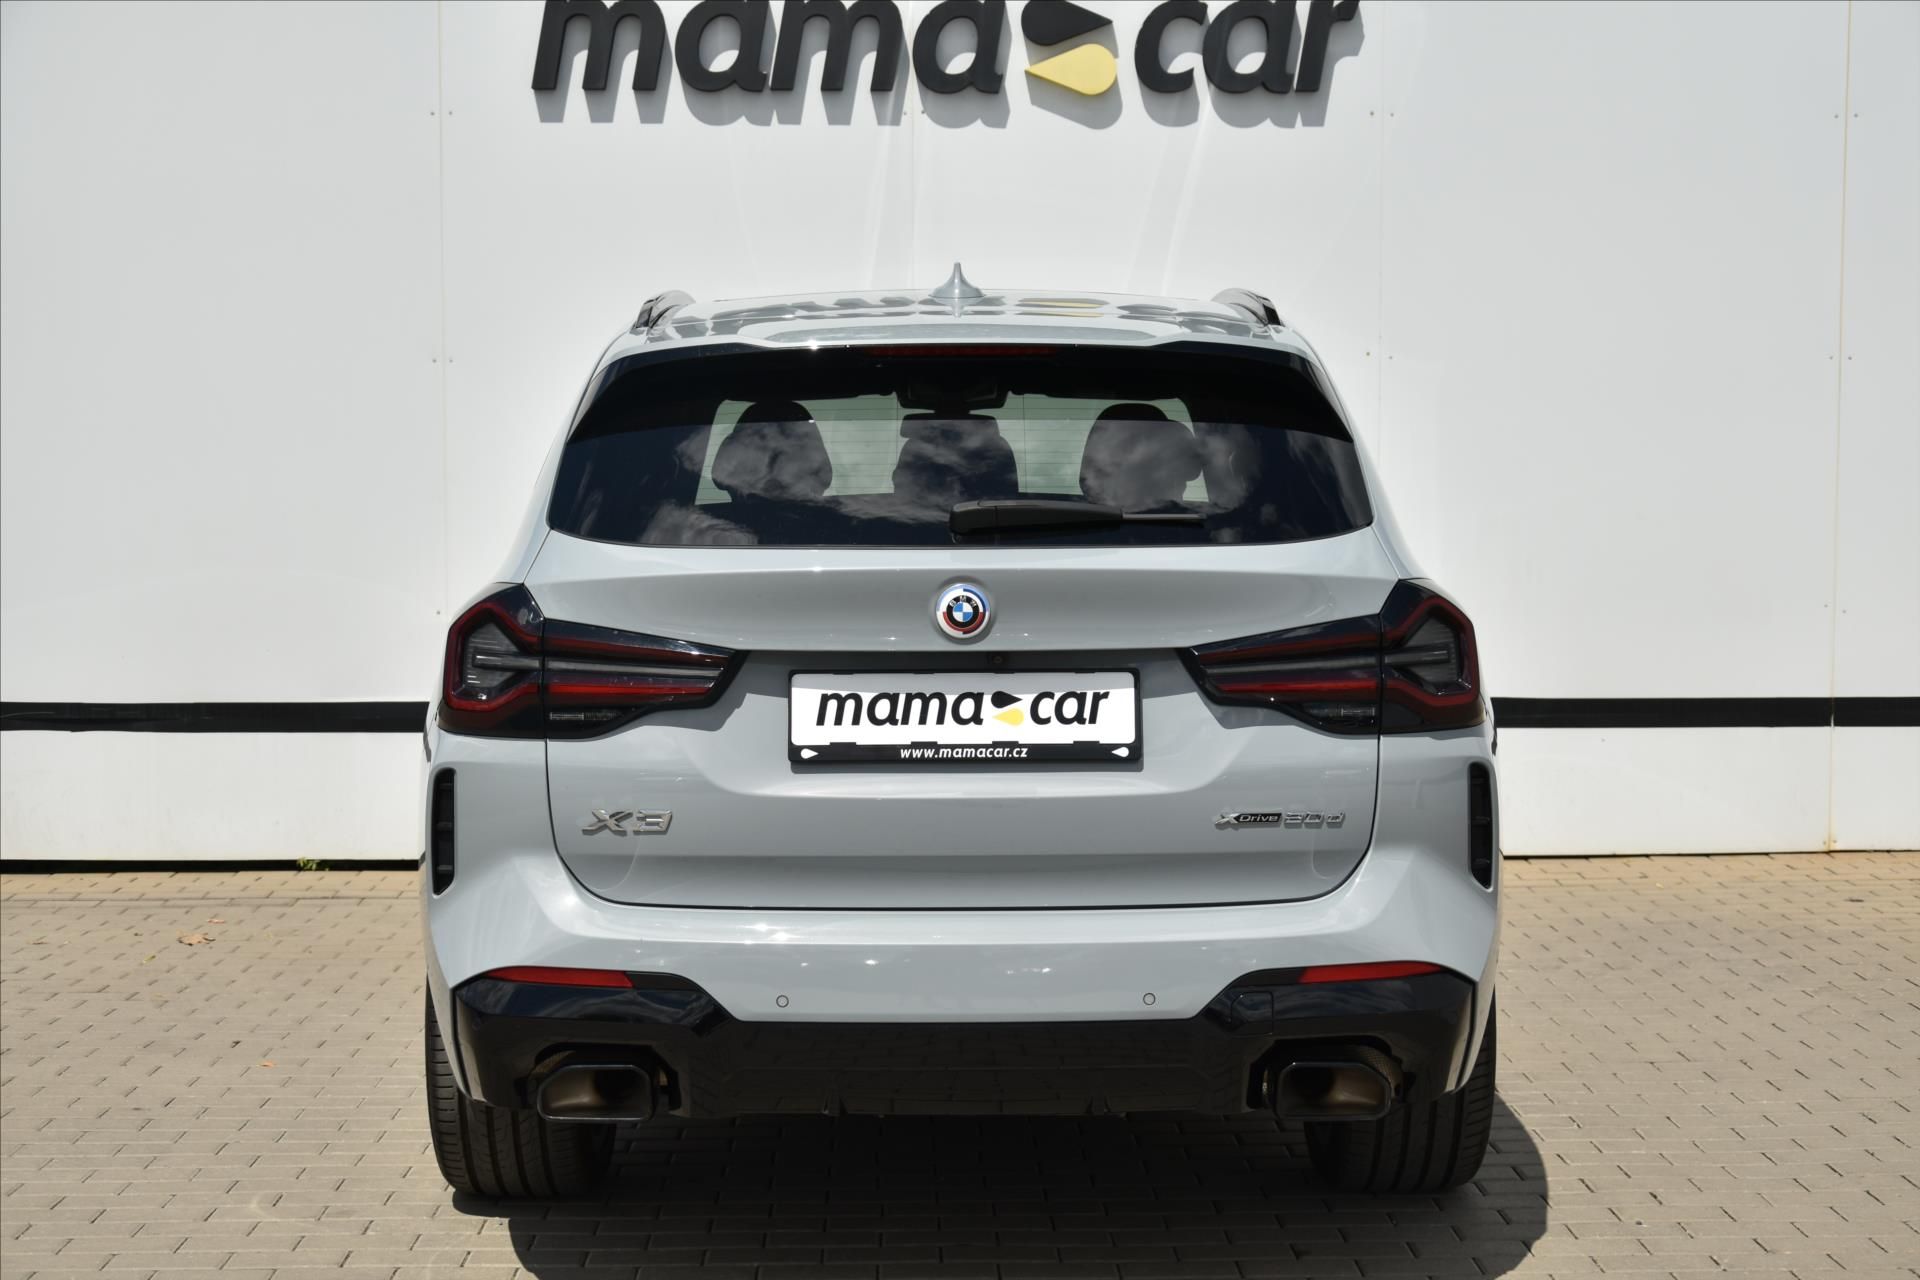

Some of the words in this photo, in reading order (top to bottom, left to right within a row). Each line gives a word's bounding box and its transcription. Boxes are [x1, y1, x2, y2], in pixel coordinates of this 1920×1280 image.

[531, 0, 1004, 94] mama
[1135, 0, 1358, 94] car
[817, 691, 983, 726] mama
[1030, 691, 1110, 725] car
[901, 746, 1028, 759] www.mamacar.cz
[582, 808, 674, 834] X3
